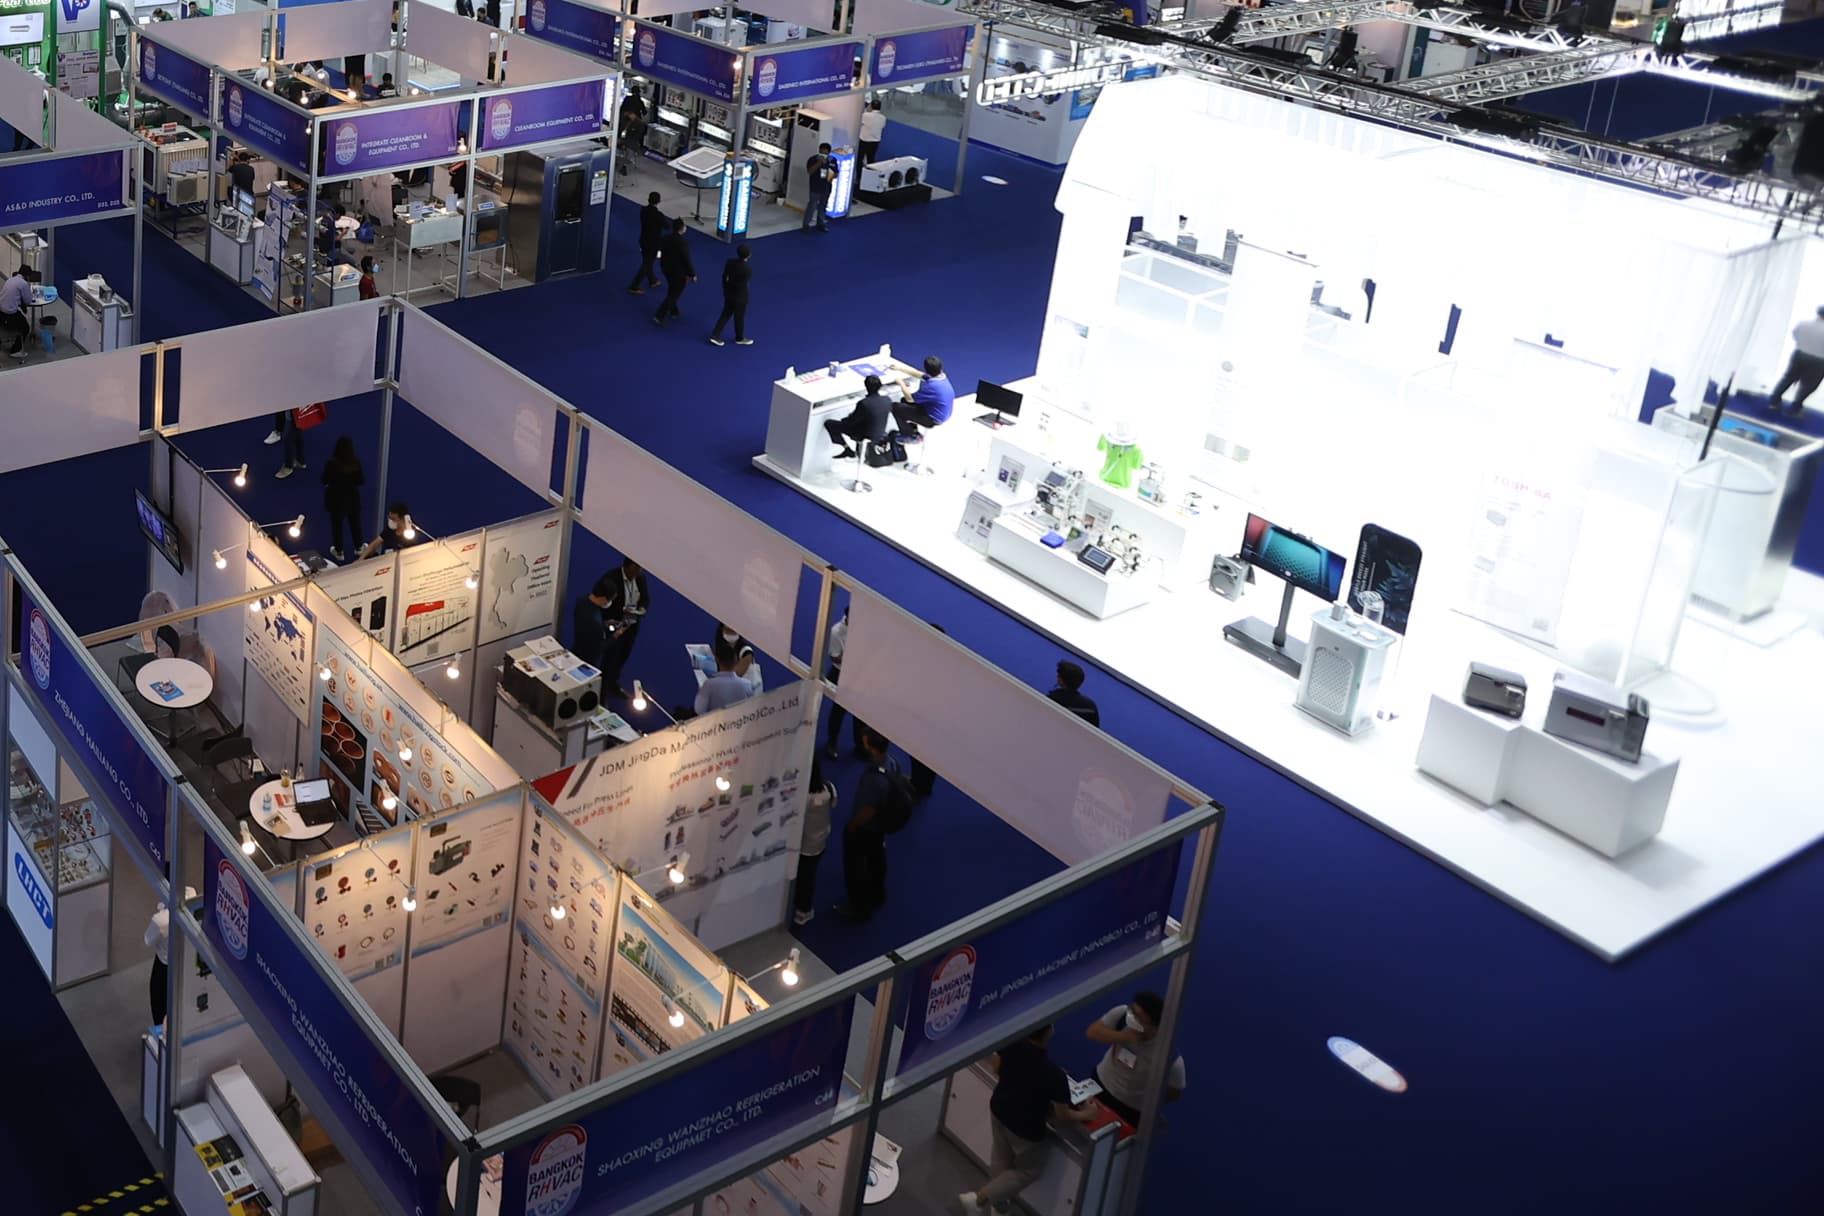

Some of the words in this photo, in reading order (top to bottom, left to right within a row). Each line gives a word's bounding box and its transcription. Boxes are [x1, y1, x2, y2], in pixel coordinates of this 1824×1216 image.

[29, 197, 62, 209] INDUSTRY
[54, 689, 85, 738] ZHEJIANG
[86, 735, 119, 785] HAILIANG
[136, 804, 151, 829] LTD.
[598, 759, 626, 778] JDM
[215, 895, 249, 938] RHVAC
[218, 879, 249, 926] BANGKOK
[928, 983, 970, 1015] RHVAC
[929, 972, 973, 1000] BANGKOK
[256, 952, 297, 1014] SHAOXING
[299, 1009, 346, 1079] WANZHAO
[348, 1072, 418, 1176] REFRIGERATION
[354, 1097, 372, 1128] LTD.
[598, 1137, 664, 1177] SHAOXING
[667, 1105, 733, 1145] WANZHAO
[735, 1065, 820, 1114] REFRIGERATION
[655, 1128, 714, 1163] EQUIPMET
[743, 1105, 763, 1122] LTD.
[527, 1163, 584, 1202] RHVAC
[528, 1151, 584, 1185] BANGKOK
